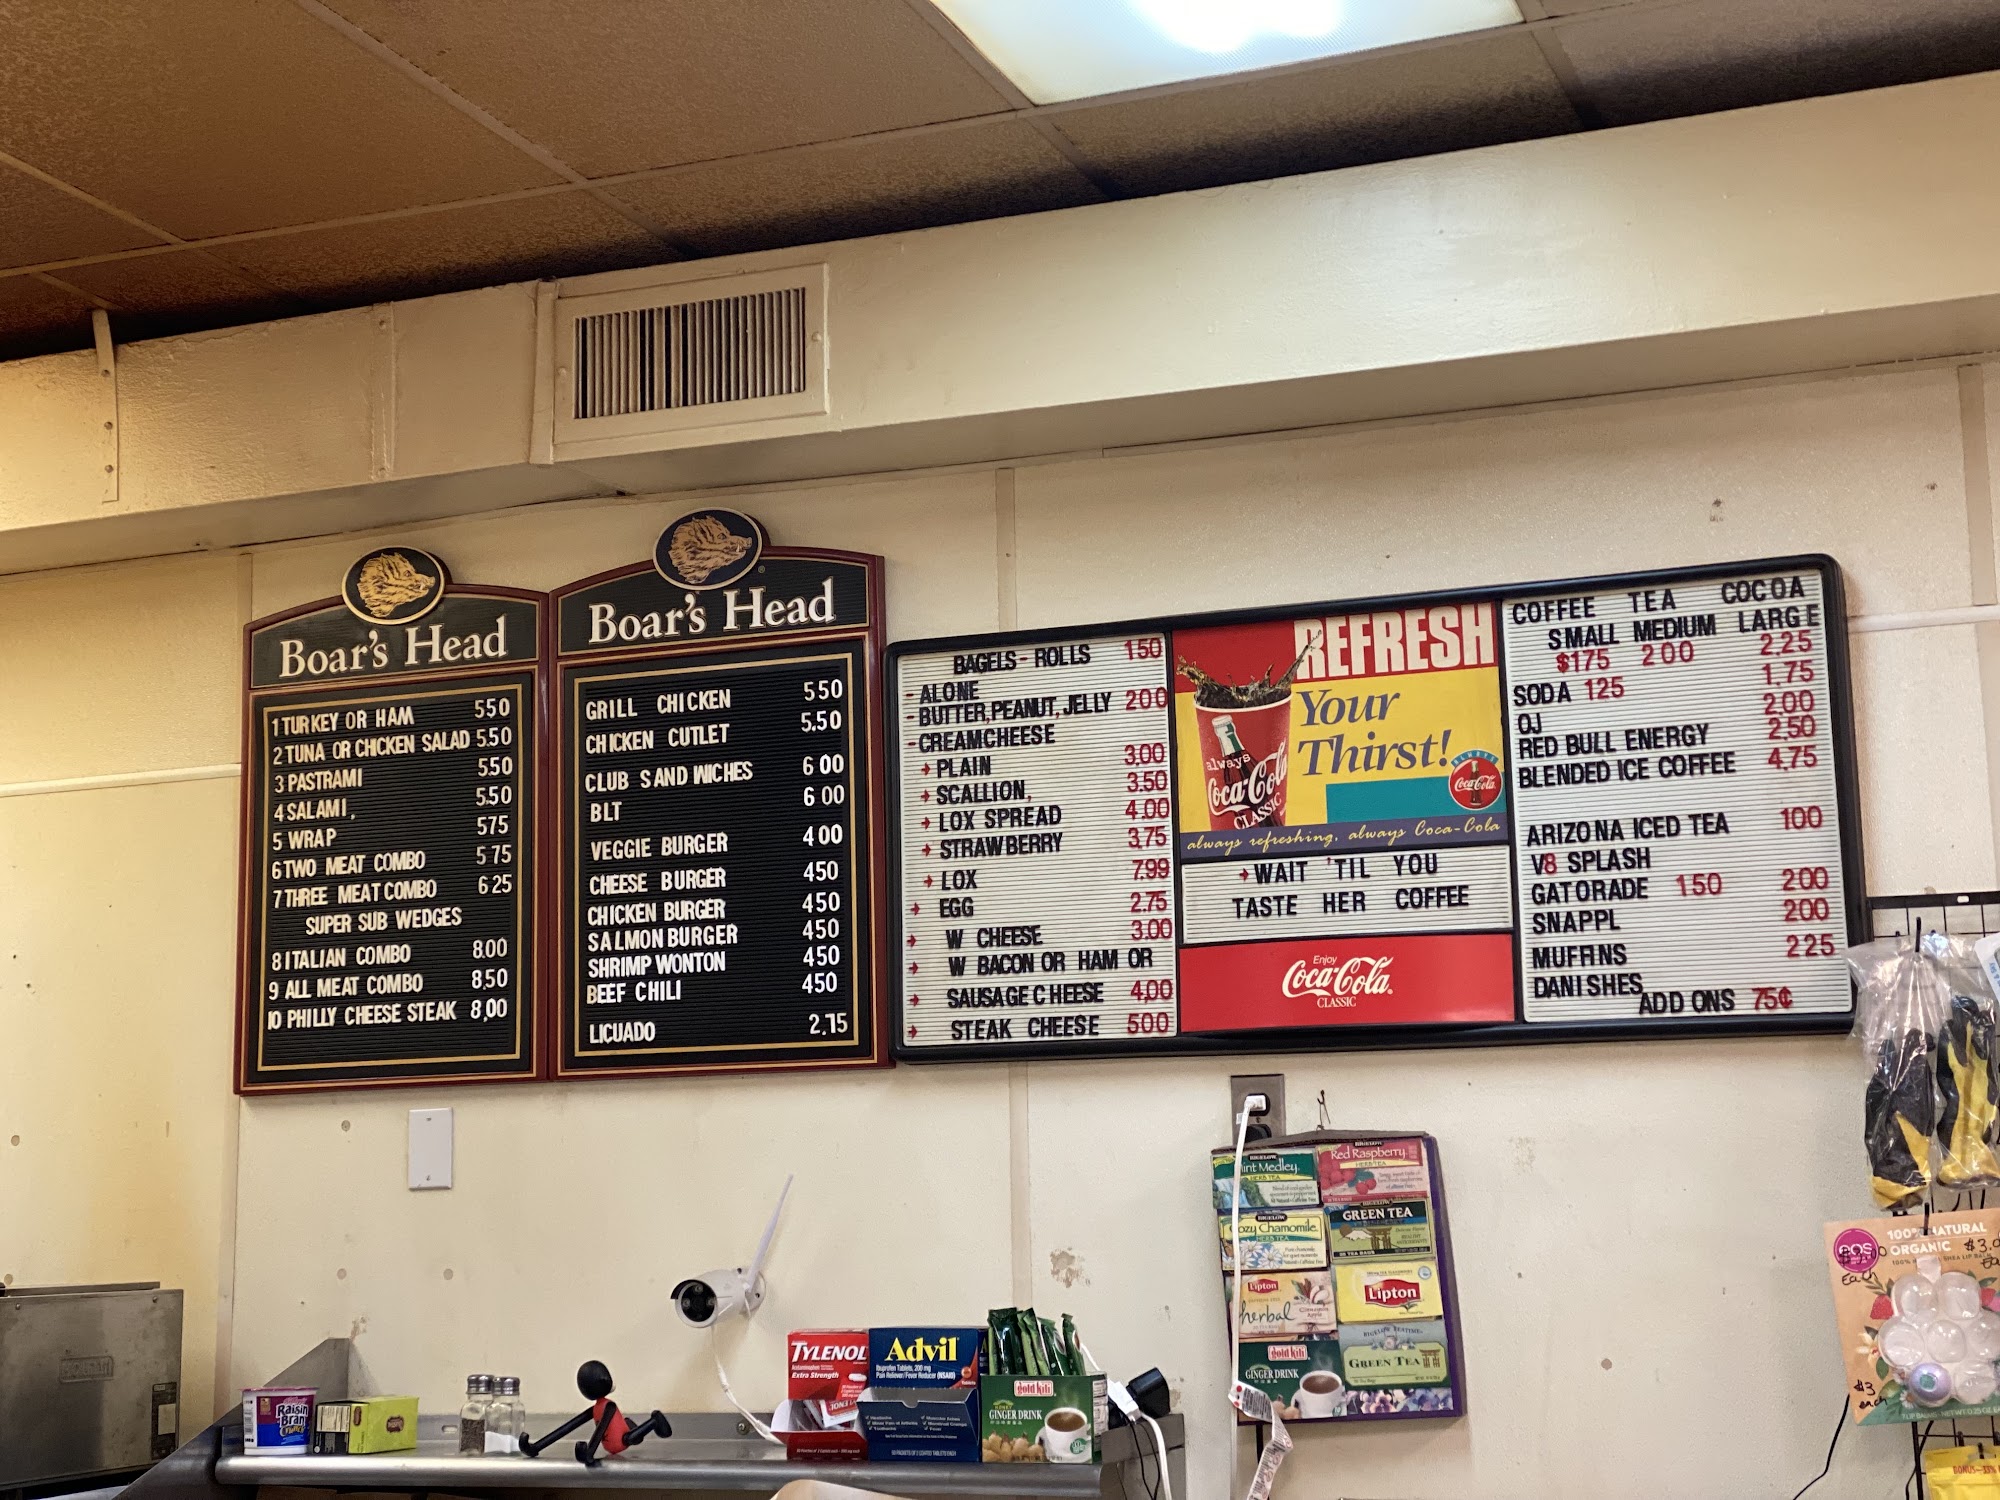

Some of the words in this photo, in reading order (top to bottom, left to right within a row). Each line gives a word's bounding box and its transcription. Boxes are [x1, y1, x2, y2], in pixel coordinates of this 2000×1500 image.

[589, 592, 706, 644] Boar's
[723, 576, 836, 631] Head
[1512, 597, 1595, 625] COFFEE
[1629, 589, 1676, 613] TEA
[1722, 576, 1804, 604] COCOA
[1549, 624, 1619, 650] SMALL
[1633, 614, 1717, 642] MEDIUM
[1739, 605, 1819, 633] LARGE
[280, 630, 388, 678] Boar's
[405, 614, 506, 666] Head
[1294, 603, 1494, 680] REFRESH
[1035, 644, 1091, 668] ROLLS
[586, 698, 638, 720] GRILL
[657, 689, 730, 714] CHICKEN
[920, 681, 979, 703] ALONE
[1126, 687, 1167, 711] 200
[1513, 682, 1571, 707] SODA
[1584, 677, 1624, 701] 125
[282, 712, 339, 735] TURKEY
[346, 710, 366, 729] OR
[375, 706, 414, 728] HAM
[1296, 689, 1400, 726] Your
[586, 730, 654, 754] CHICKEN
[668, 724, 730, 748] CUTLET
[801, 710, 842, 733] 5.50
[1519, 736, 1558, 760] RED
[1566, 732, 1616, 755] BULL
[1625, 723, 1709, 751] ENERGY
[285, 743, 325, 764] TUNA
[333, 741, 351, 759] OR
[355, 735, 415, 757] CHICKEN
[422, 730, 470, 752] SALAD
[1297, 729, 1451, 776] Thirst!
[937, 756, 991, 778] PLAIN
[1206, 754, 1250, 771] always
[1519, 761, 1609, 789] BLENDED
[1618, 758, 1649, 782] ICE
[1659, 751, 1736, 778] COFFEE
[288, 768, 362, 792] PASTRAMI
[585, 772, 629, 793] CLUB
[590, 802, 622, 822] BLT
[940, 811, 974, 832] LOX
[985, 805, 1062, 828] SPREAD
[1234, 792, 1281, 829] CLASSIC
[1634, 816, 1680, 839] ICED
[1689, 812, 1729, 836] TEA
[1780, 805, 1822, 830] 100
[289, 828, 336, 849] WRAP
[477, 815, 509, 835] 575
[1187, 834, 1242, 856] always
[1348, 821, 1406, 846] always
[1415, 817, 1500, 837] Coca-Cola
[590, 838, 652, 861] VEGGIE
[661, 832, 728, 856] BURGER
[940, 832, 1062, 860] STRAWBERRY
[284, 858, 316, 879] TWO
[326, 855, 365, 876] MEAT
[374, 851, 425, 872] COMBO
[1254, 861, 1308, 884] WAIT
[1394, 853, 1437, 876] YOU
[1531, 853, 1557, 875] V8
[1568, 847, 1650, 873] SPLASH
[590, 872, 648, 895] CHEESE
[661, 867, 726, 891] BURGER
[942, 870, 977, 890] LOX
[1531, 877, 1648, 905] GATORADE
[1782, 867, 1828, 891] 200
[940, 897, 973, 918] EGG
[1232, 895, 1297, 919] TASTE
[1323, 891, 1366, 913] HER
[1396, 885, 1469, 909] COFFEE
[1532, 909, 1620, 934] SNAPPL
[1784, 897, 1829, 922] 200
[306, 914, 352, 935] SUPER
[358, 911, 387, 931] SUB
[395, 907, 462, 930] WEDGES
[588, 928, 663, 952] SALMON
[668, 924, 738, 948] BURGER
[946, 929, 963, 949] W
[977, 925, 1043, 948] CHEESE
[285, 948, 346, 969] ITALIAN
[356, 944, 411, 966] COMBO
[588, 955, 650, 978] SHRIMP
[656, 952, 726, 975] WONTON
[949, 957, 966, 976] W
[978, 953, 1033, 975] BACON
[1041, 951, 1065, 972] OR
[1079, 950, 1118, 970] HAM
[1129, 948, 1152, 968] OR
[1313, 955, 1337, 966] Enjoy
[1532, 943, 1626, 969] MUFFINS
[285, 980, 311, 1000] ALL
[317, 976, 359, 998] MEAT
[367, 973, 423, 994] COMBO
[1282, 955, 1393, 997] Coca-Cola
[586, 982, 626, 1004] BEEF
[635, 980, 681, 1002] CHILI
[947, 985, 1028, 1008] SAUSAGE
[1317, 996, 1356, 1008] CLASSIC
[1639, 991, 1684, 1015] ADD
[1692, 988, 1735, 1013] ONS
[287, 1007, 337, 1028] PHILLY
[345, 1003, 401, 1025] CHEESE
[407, 1001, 457, 1022] STEAK
[590, 1022, 656, 1044] LICUADO
[809, 1012, 848, 1036] 2.75
[951, 1019, 1011, 1040] STEAK
[1028, 1015, 1099, 1038] CHEESE
[1127, 1012, 1168, 1034] 500
[1259, 1158, 1297, 1174] Medley
[1331, 1146, 1350, 1160] Red
[1352, 1149, 1406, 1161] Raspberry
[1259, 1219, 1317, 1233] Chamomile
[1343, 1210, 1385, 1220] GREEN
[1387, 1207, 1413, 1218] TEA
[1890, 1241, 1951, 1255] ORGANIC
[1249, 1282, 1276, 1291] Lipton
[1369, 1288, 1417, 1302] Lipton
[1240, 1301, 1295, 1325] herbal
[1364, 1326, 1390, 1337] BIGELOW
[791, 1342, 867, 1362] TYLENOL
[884, 1337, 957, 1361] Advil
[1271, 1346, 1289, 1359] gold
[1291, 1346, 1304, 1358] kili
[1349, 1359, 1391, 1368] GREEN
[1393, 1357, 1420, 1366] TEA
[1017, 1381, 1035, 1394] gold
[1037, 1381, 1050, 1394] kili
[1246, 1369, 1273, 1379] GINGER
[1275, 1369, 1299, 1378] DRINK
[276, 1404, 308, 1417] Raisin
[280, 1415, 305, 1427] Bran
[990, 1410, 1019, 1420] GINGER
[1021, 1410, 1042, 1420] DRINK
